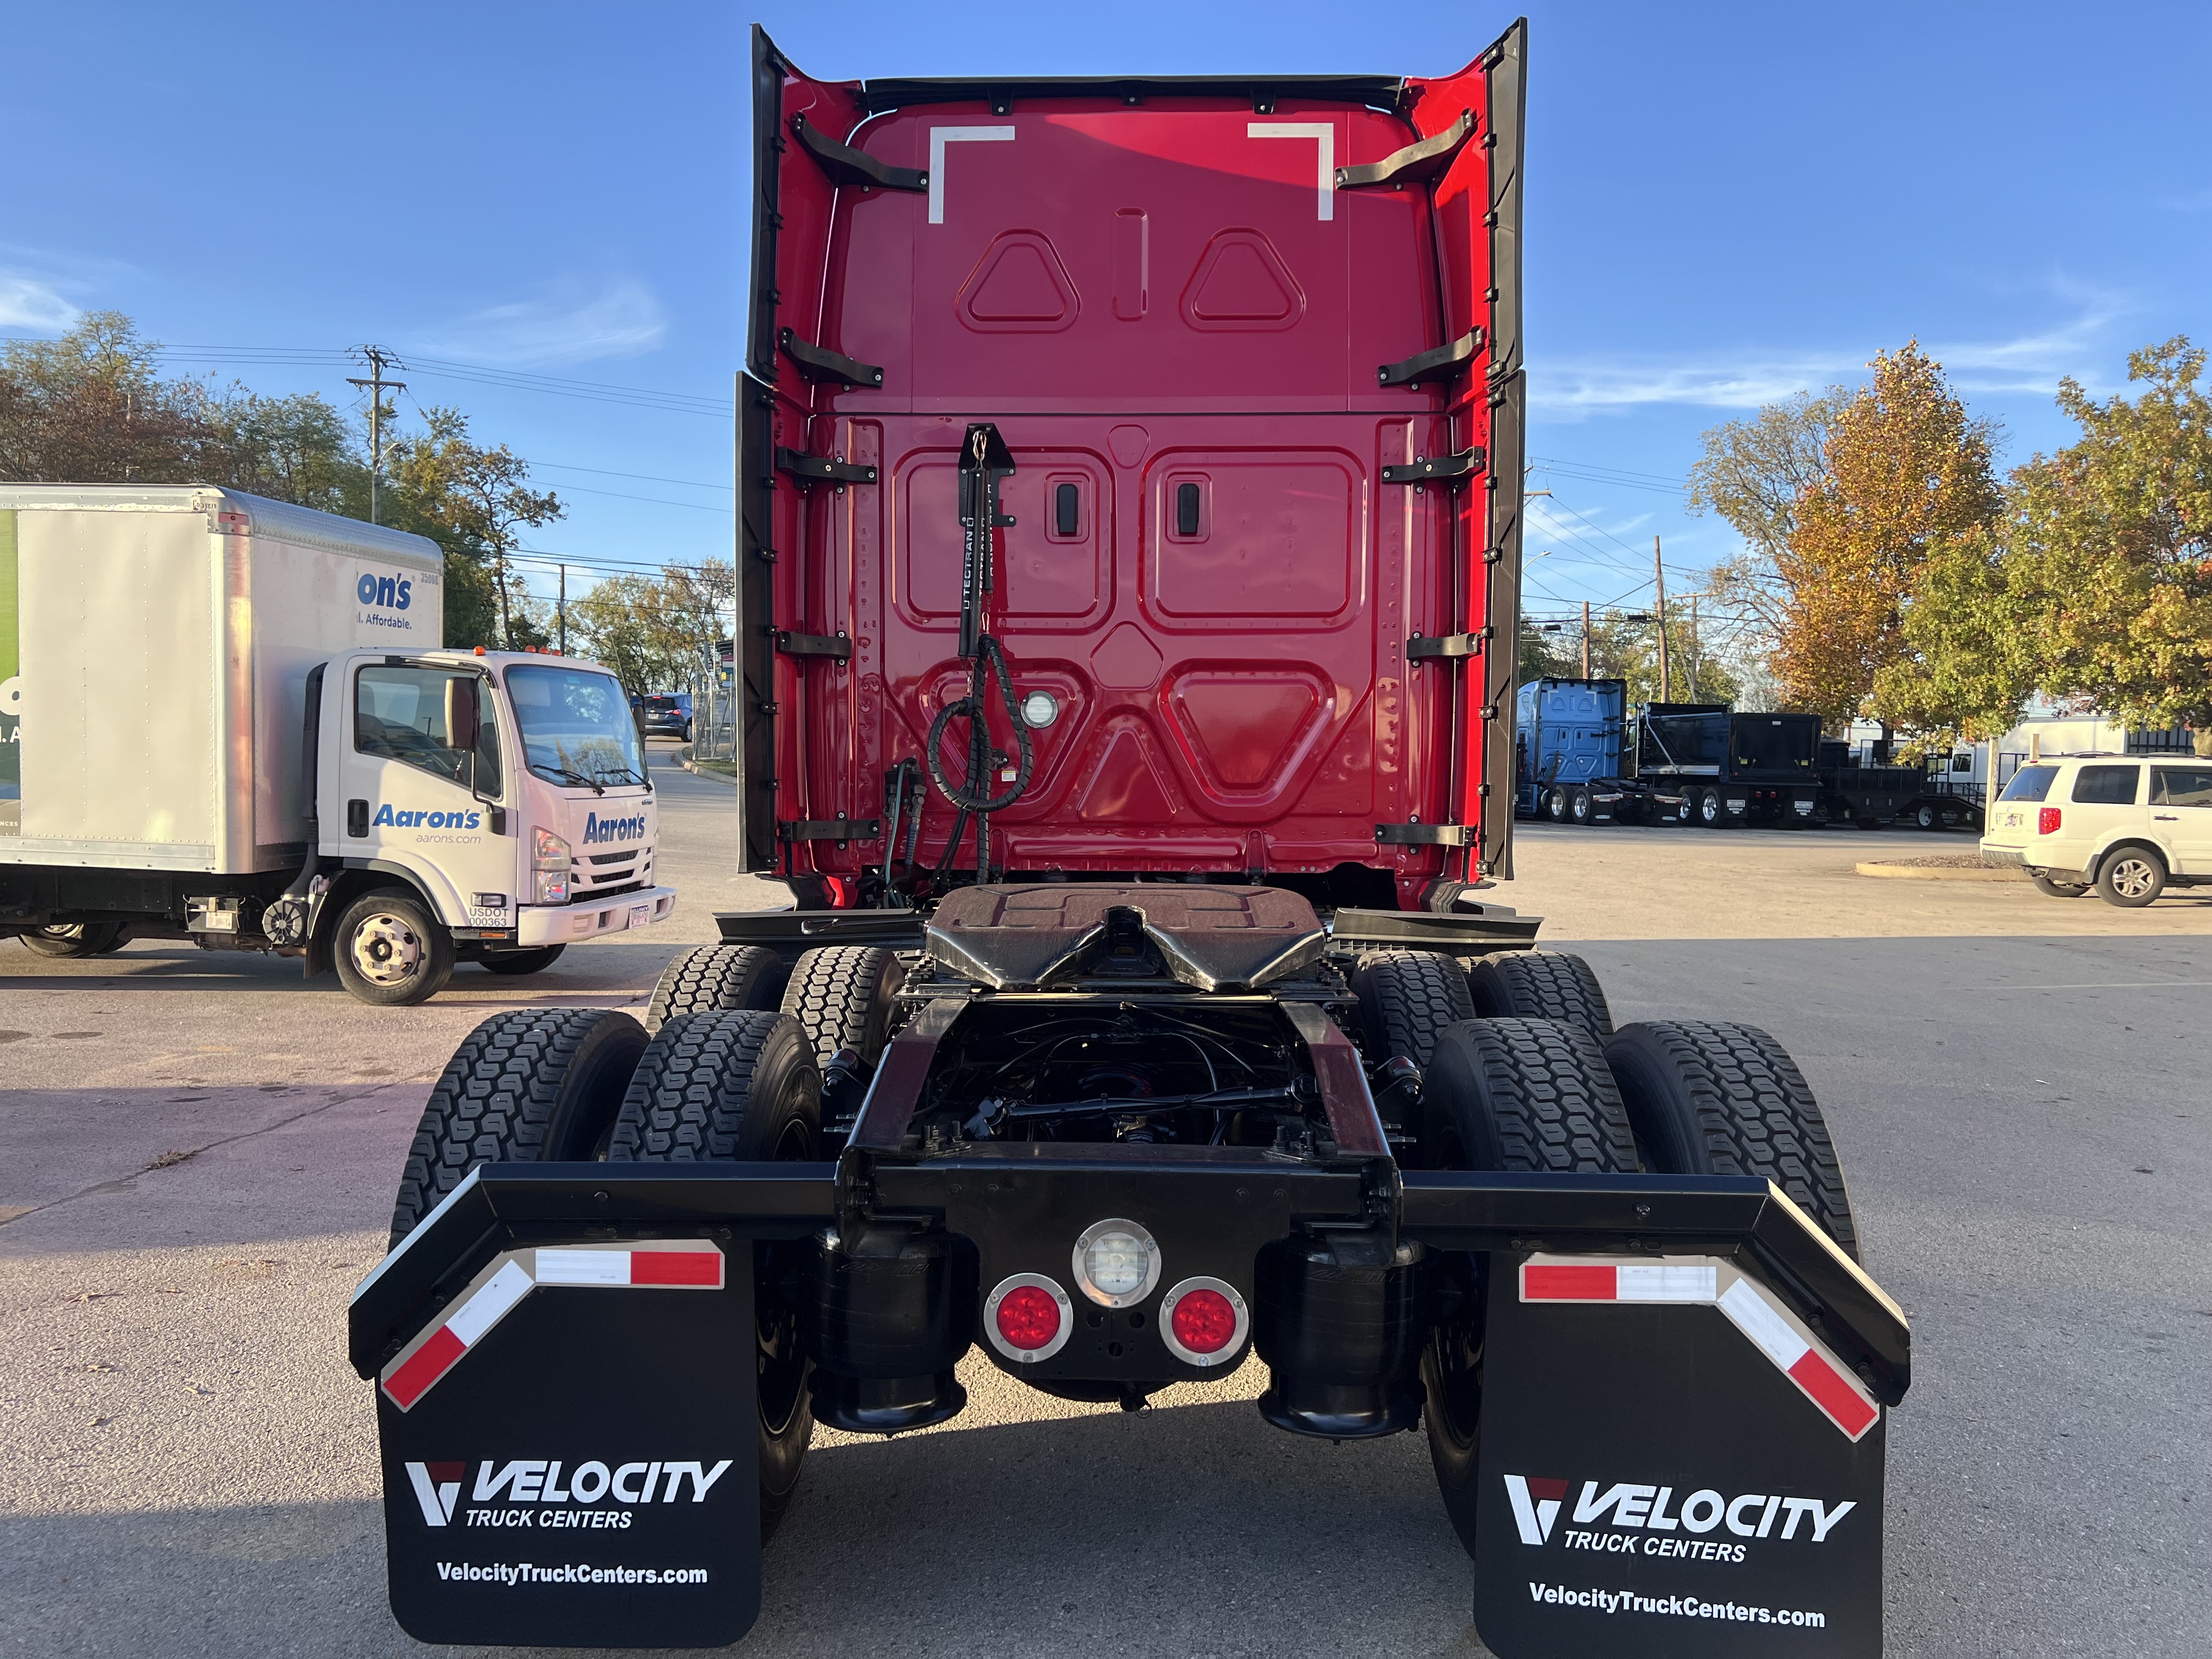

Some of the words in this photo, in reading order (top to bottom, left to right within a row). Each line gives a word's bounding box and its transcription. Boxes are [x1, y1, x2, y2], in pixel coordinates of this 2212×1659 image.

[421, 572, 438, 585] 35008
[963, 531, 973, 597] TECTRAN
[357, 572, 412, 611] on's
[365, 613, 412, 630] Affordable.
[372, 804, 481, 830] Aaron's
[582, 812, 645, 844] Aaron's
[416, 834, 481, 844] aarons.com
[470, 907, 509, 917] USDOT
[472, 1459, 733, 1504] VELOCITY
[466, 1509, 535, 1527] TRUCK
[539, 1510, 633, 1529] CENTERS
[1572, 1480, 1858, 1542] VELOCITY
[1565, 1530, 1637, 1554] TRUCK
[1644, 1537, 1747, 1563] CENTERS
[436, 1562, 708, 1587] VelocityTruckCenters.com
[1529, 1582, 1826, 1628] VelocityTruckCenters.com
